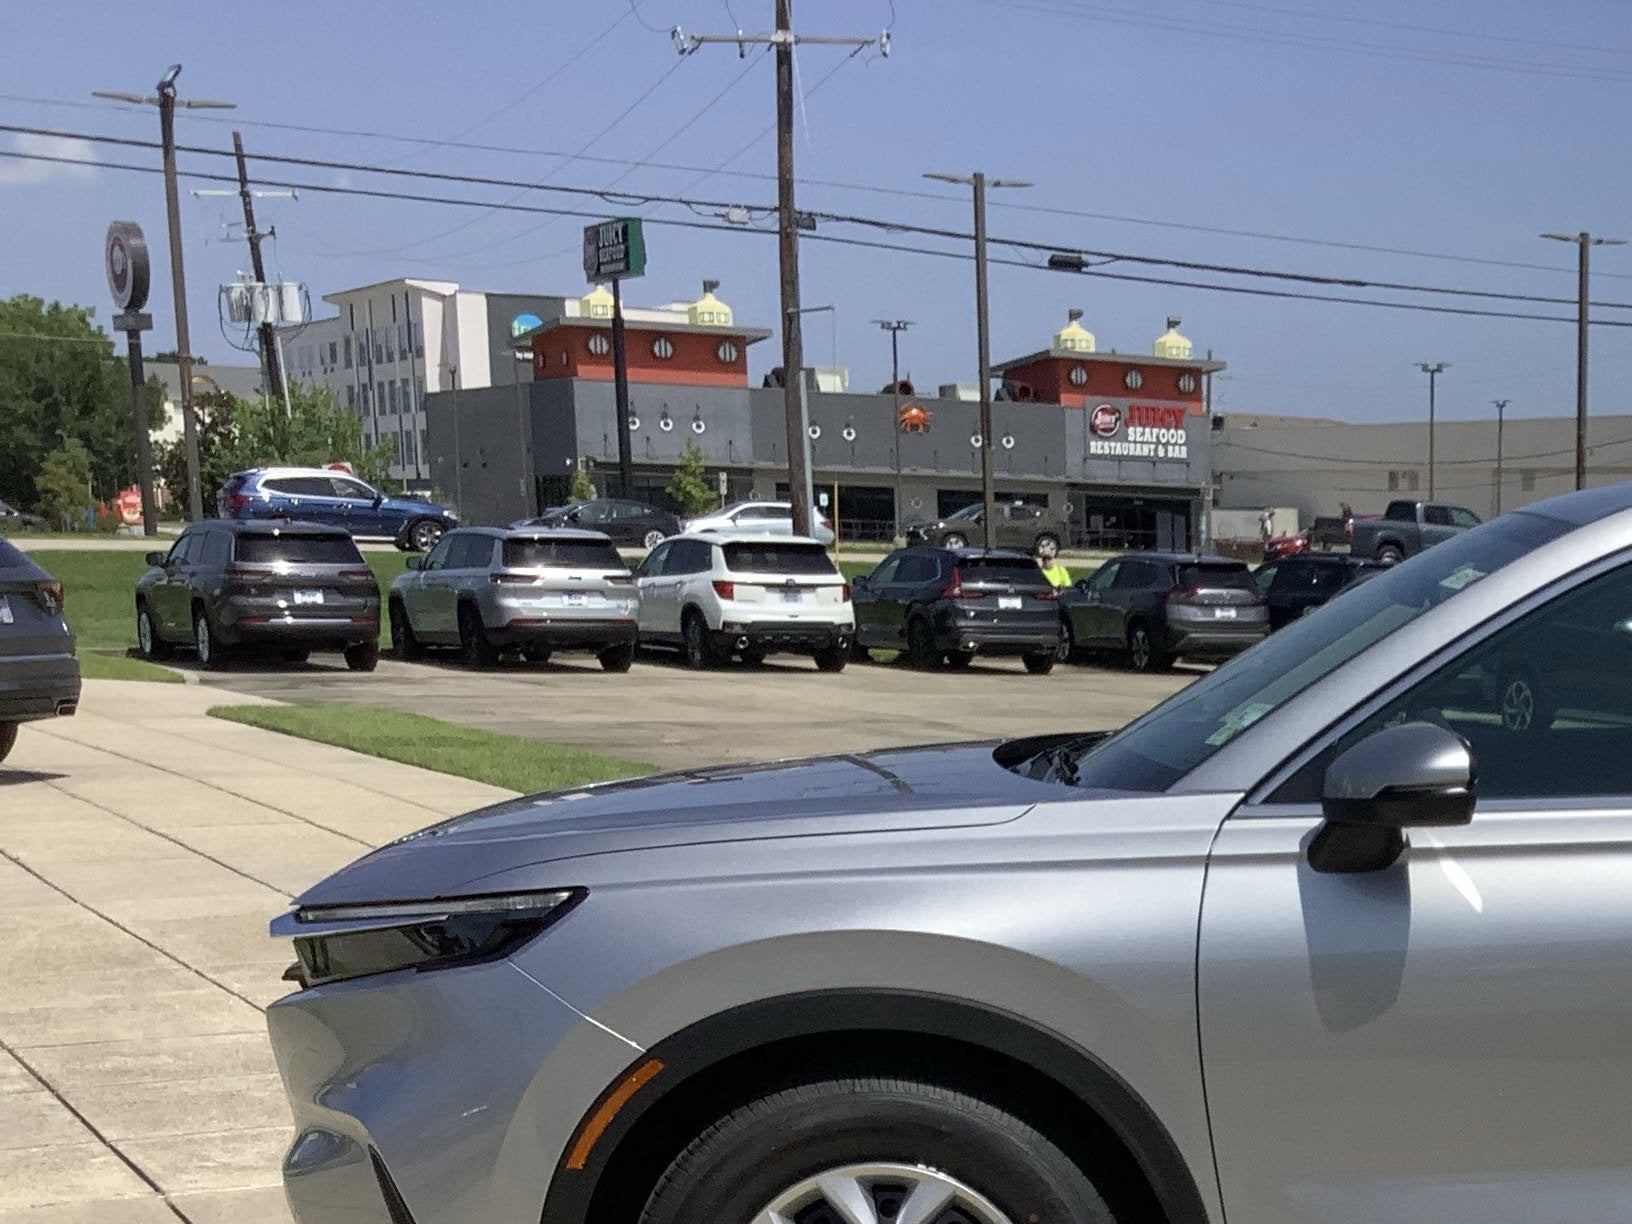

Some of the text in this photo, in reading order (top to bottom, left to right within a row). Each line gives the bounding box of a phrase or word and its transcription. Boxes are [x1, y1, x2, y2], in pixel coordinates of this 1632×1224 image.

[598, 222, 624, 248] JUICY
[1124, 405, 1185, 429] JUICY
[1127, 427, 1186, 444] SEAFOOD
[1089, 441, 1188, 459] RESTAURANT & BAR
